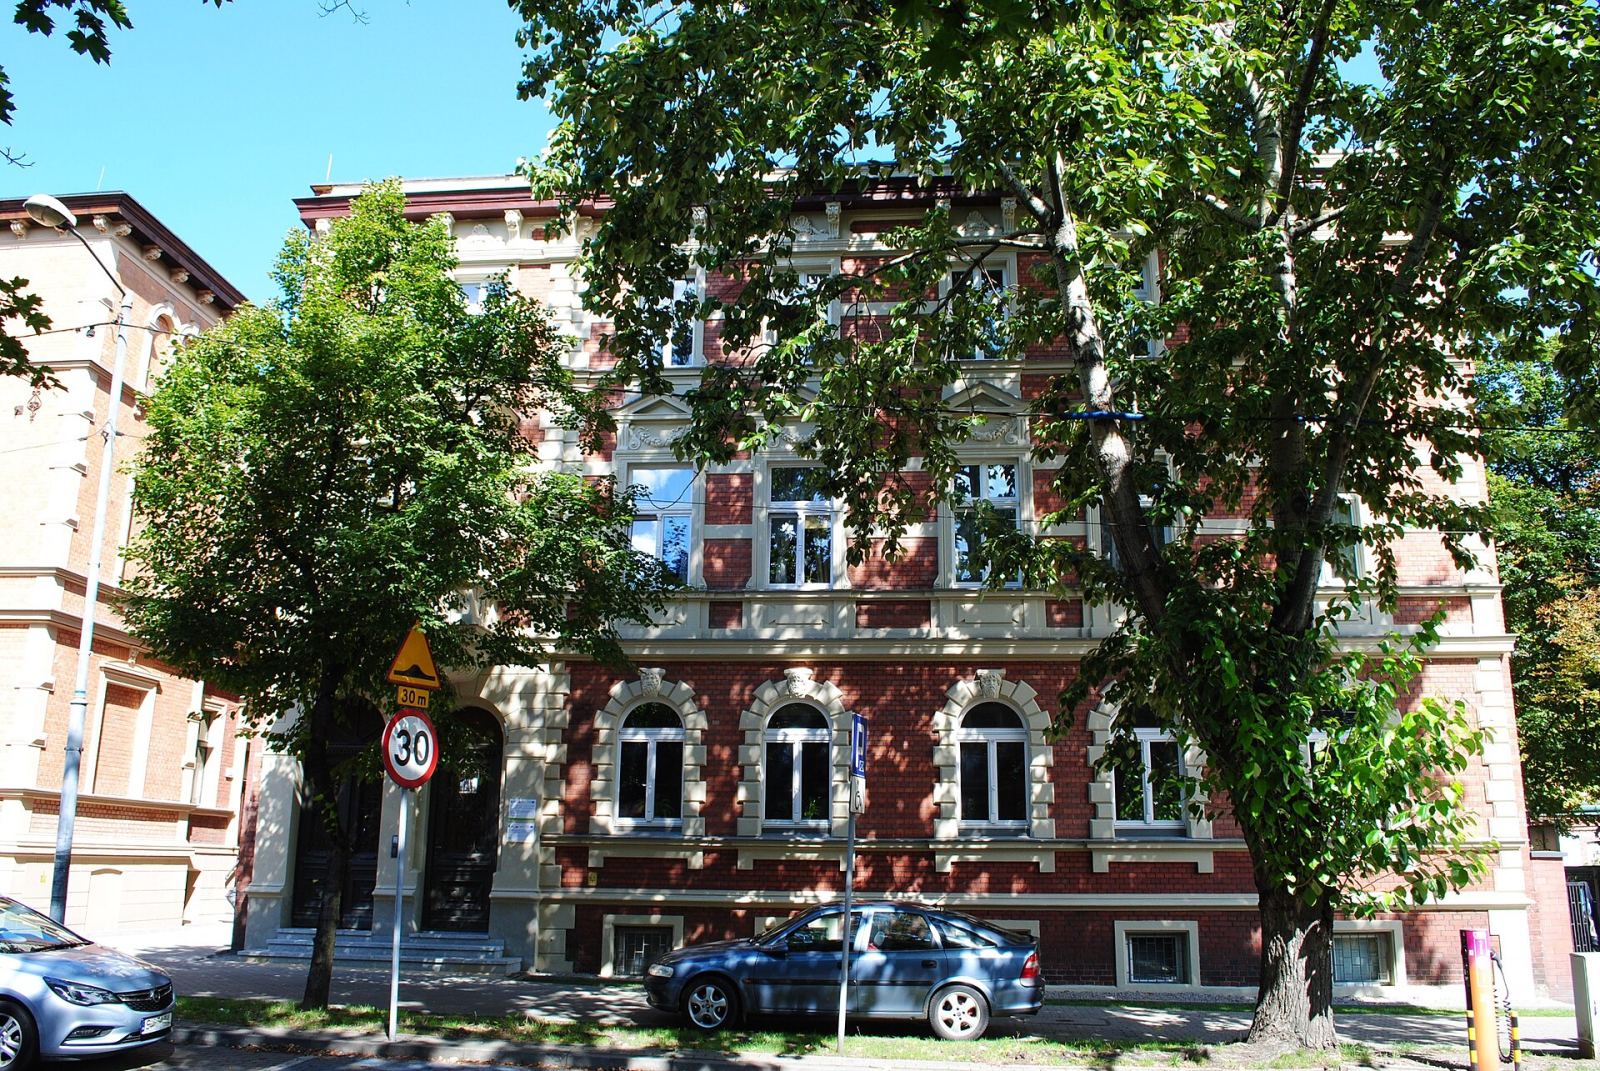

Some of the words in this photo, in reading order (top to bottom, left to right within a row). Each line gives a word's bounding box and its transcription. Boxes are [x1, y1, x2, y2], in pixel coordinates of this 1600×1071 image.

[401, 688, 416, 704] 30
[417, 695, 426, 706] m
[394, 729, 430, 767] 30
